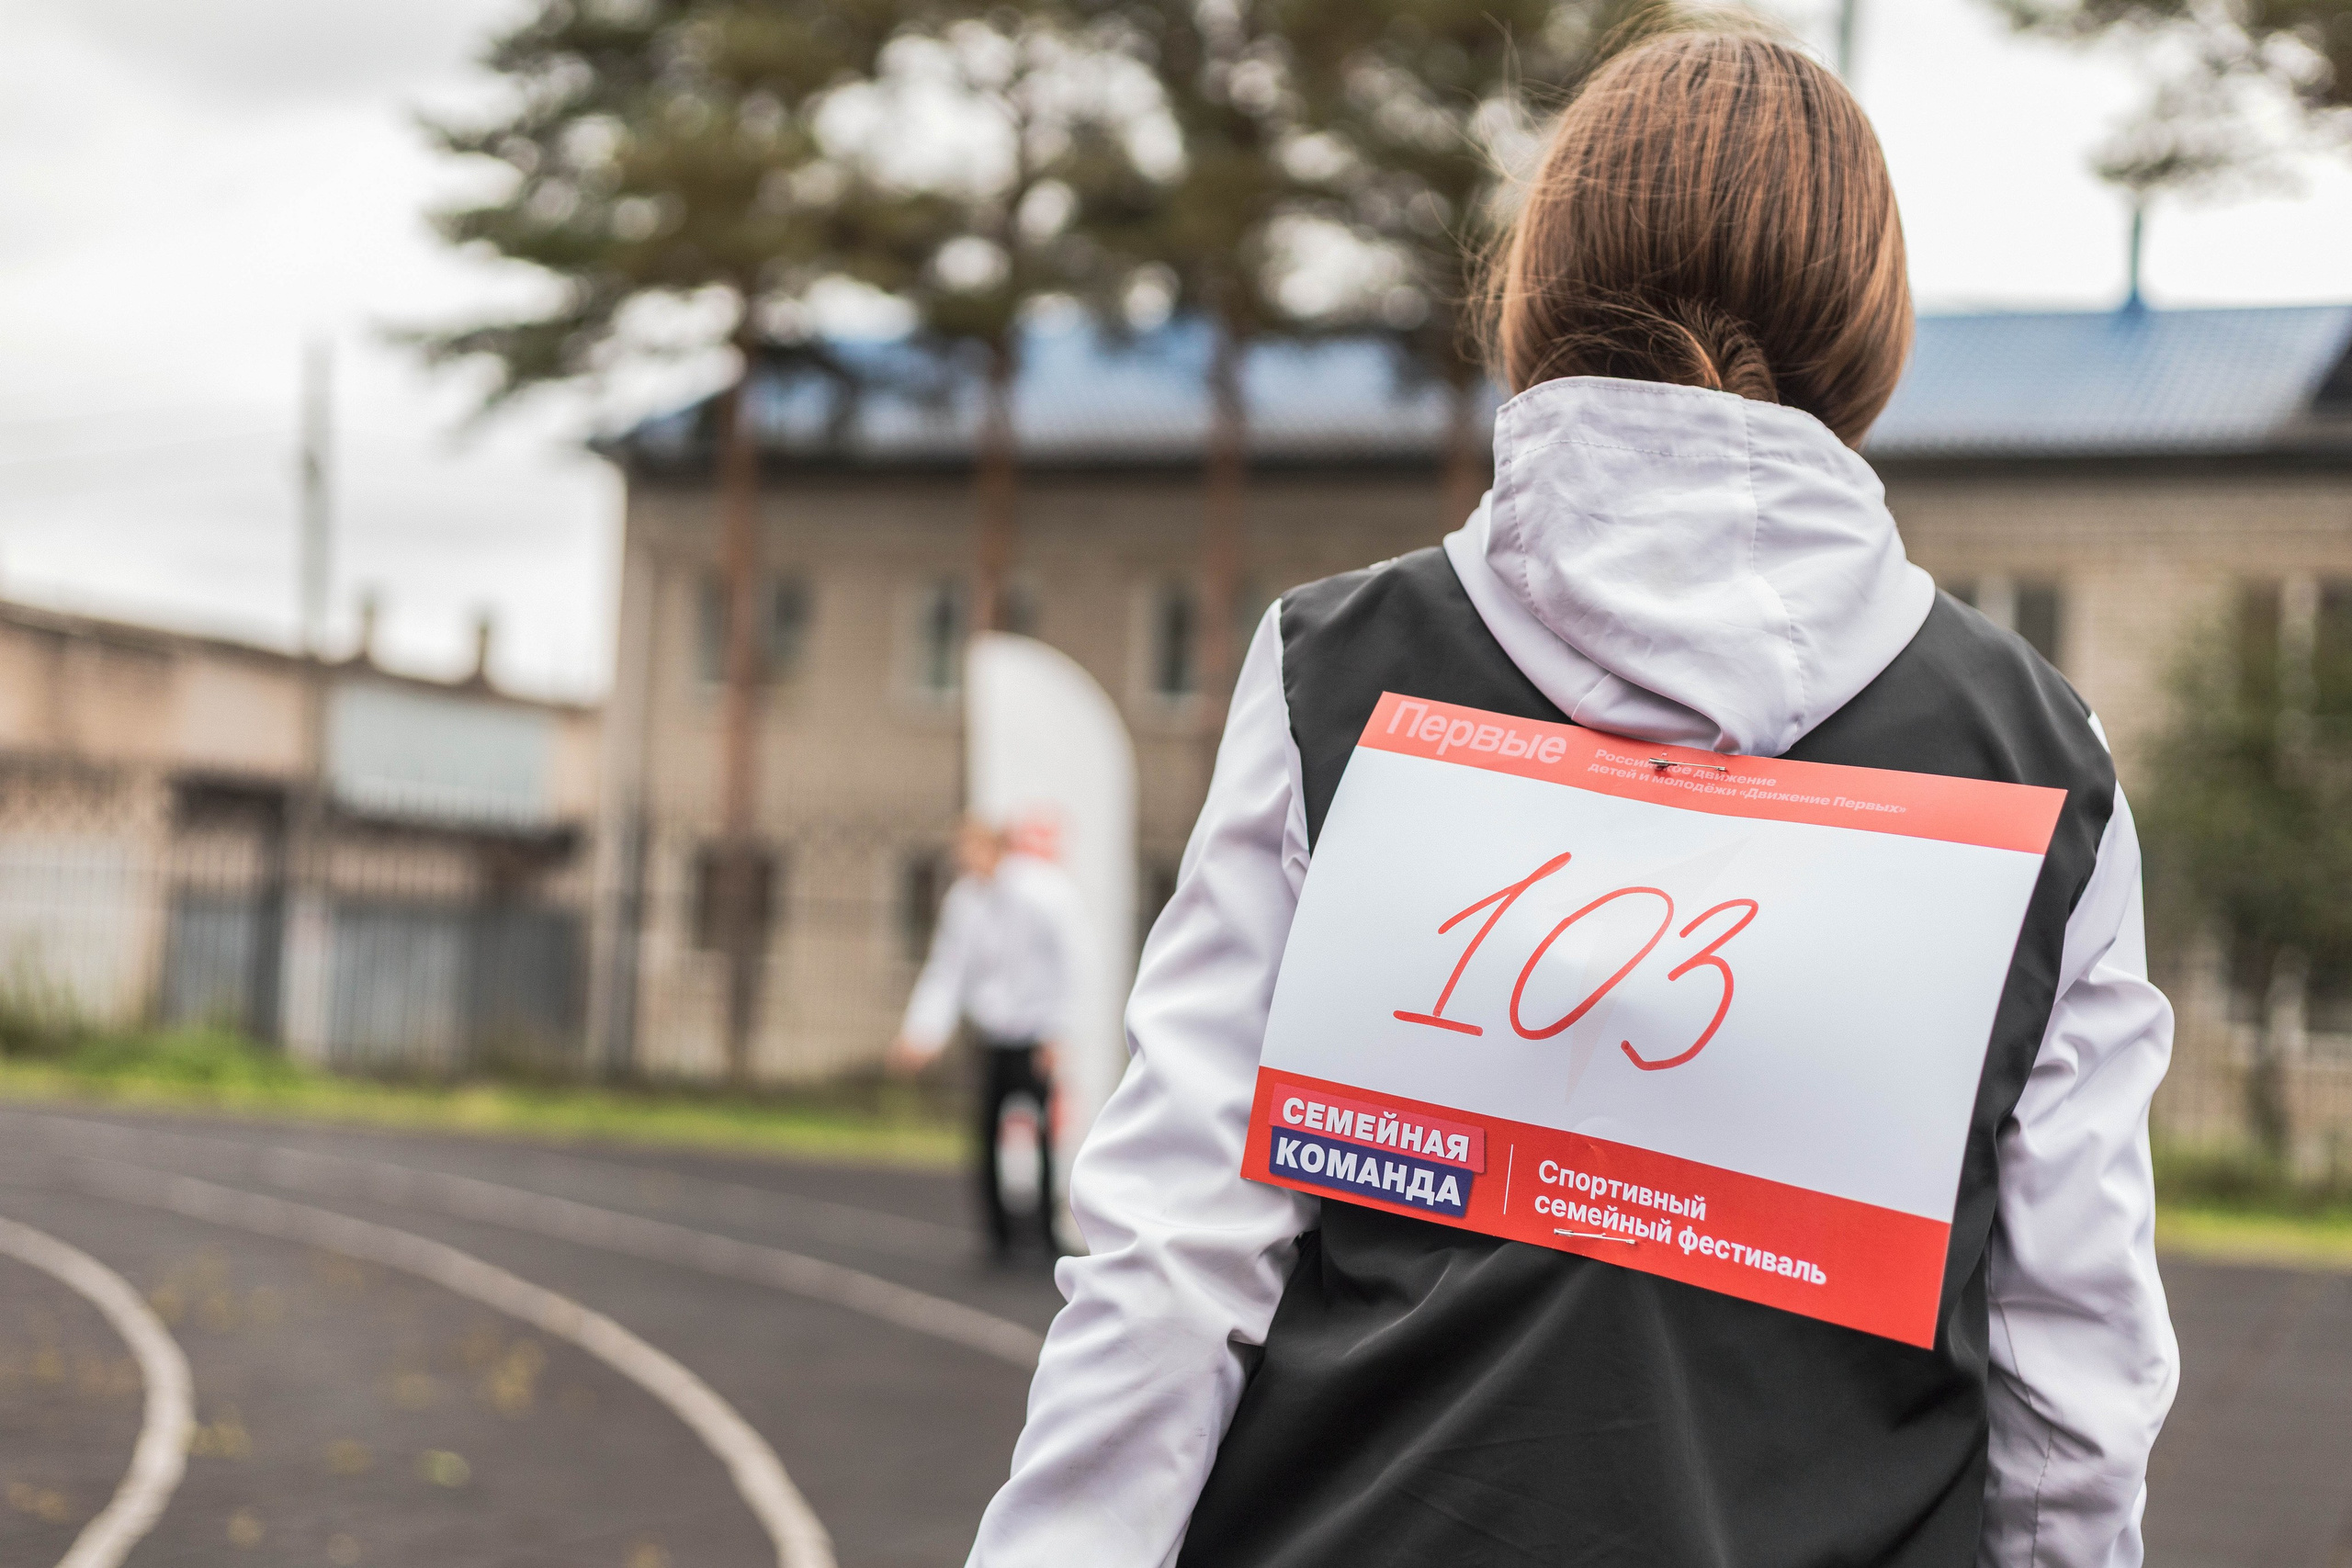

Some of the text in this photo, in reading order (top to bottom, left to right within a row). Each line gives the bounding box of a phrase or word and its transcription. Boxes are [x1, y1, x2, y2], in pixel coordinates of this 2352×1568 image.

[1386, 700, 1566, 764] Первые
[1588, 763, 1906, 813] детей и молодёжи «Движение Первых»
[1693, 770, 1776, 786] движение
[1393, 852, 1758, 1071] 103
[1283, 1098, 1470, 1162] СЕМЕЙНАЯ
[1276, 1137, 1462, 1206] КОМАНДА
[1538, 1160, 1707, 1221] Спортивный
[1534, 1196, 1827, 1285] семейный фестиваль
